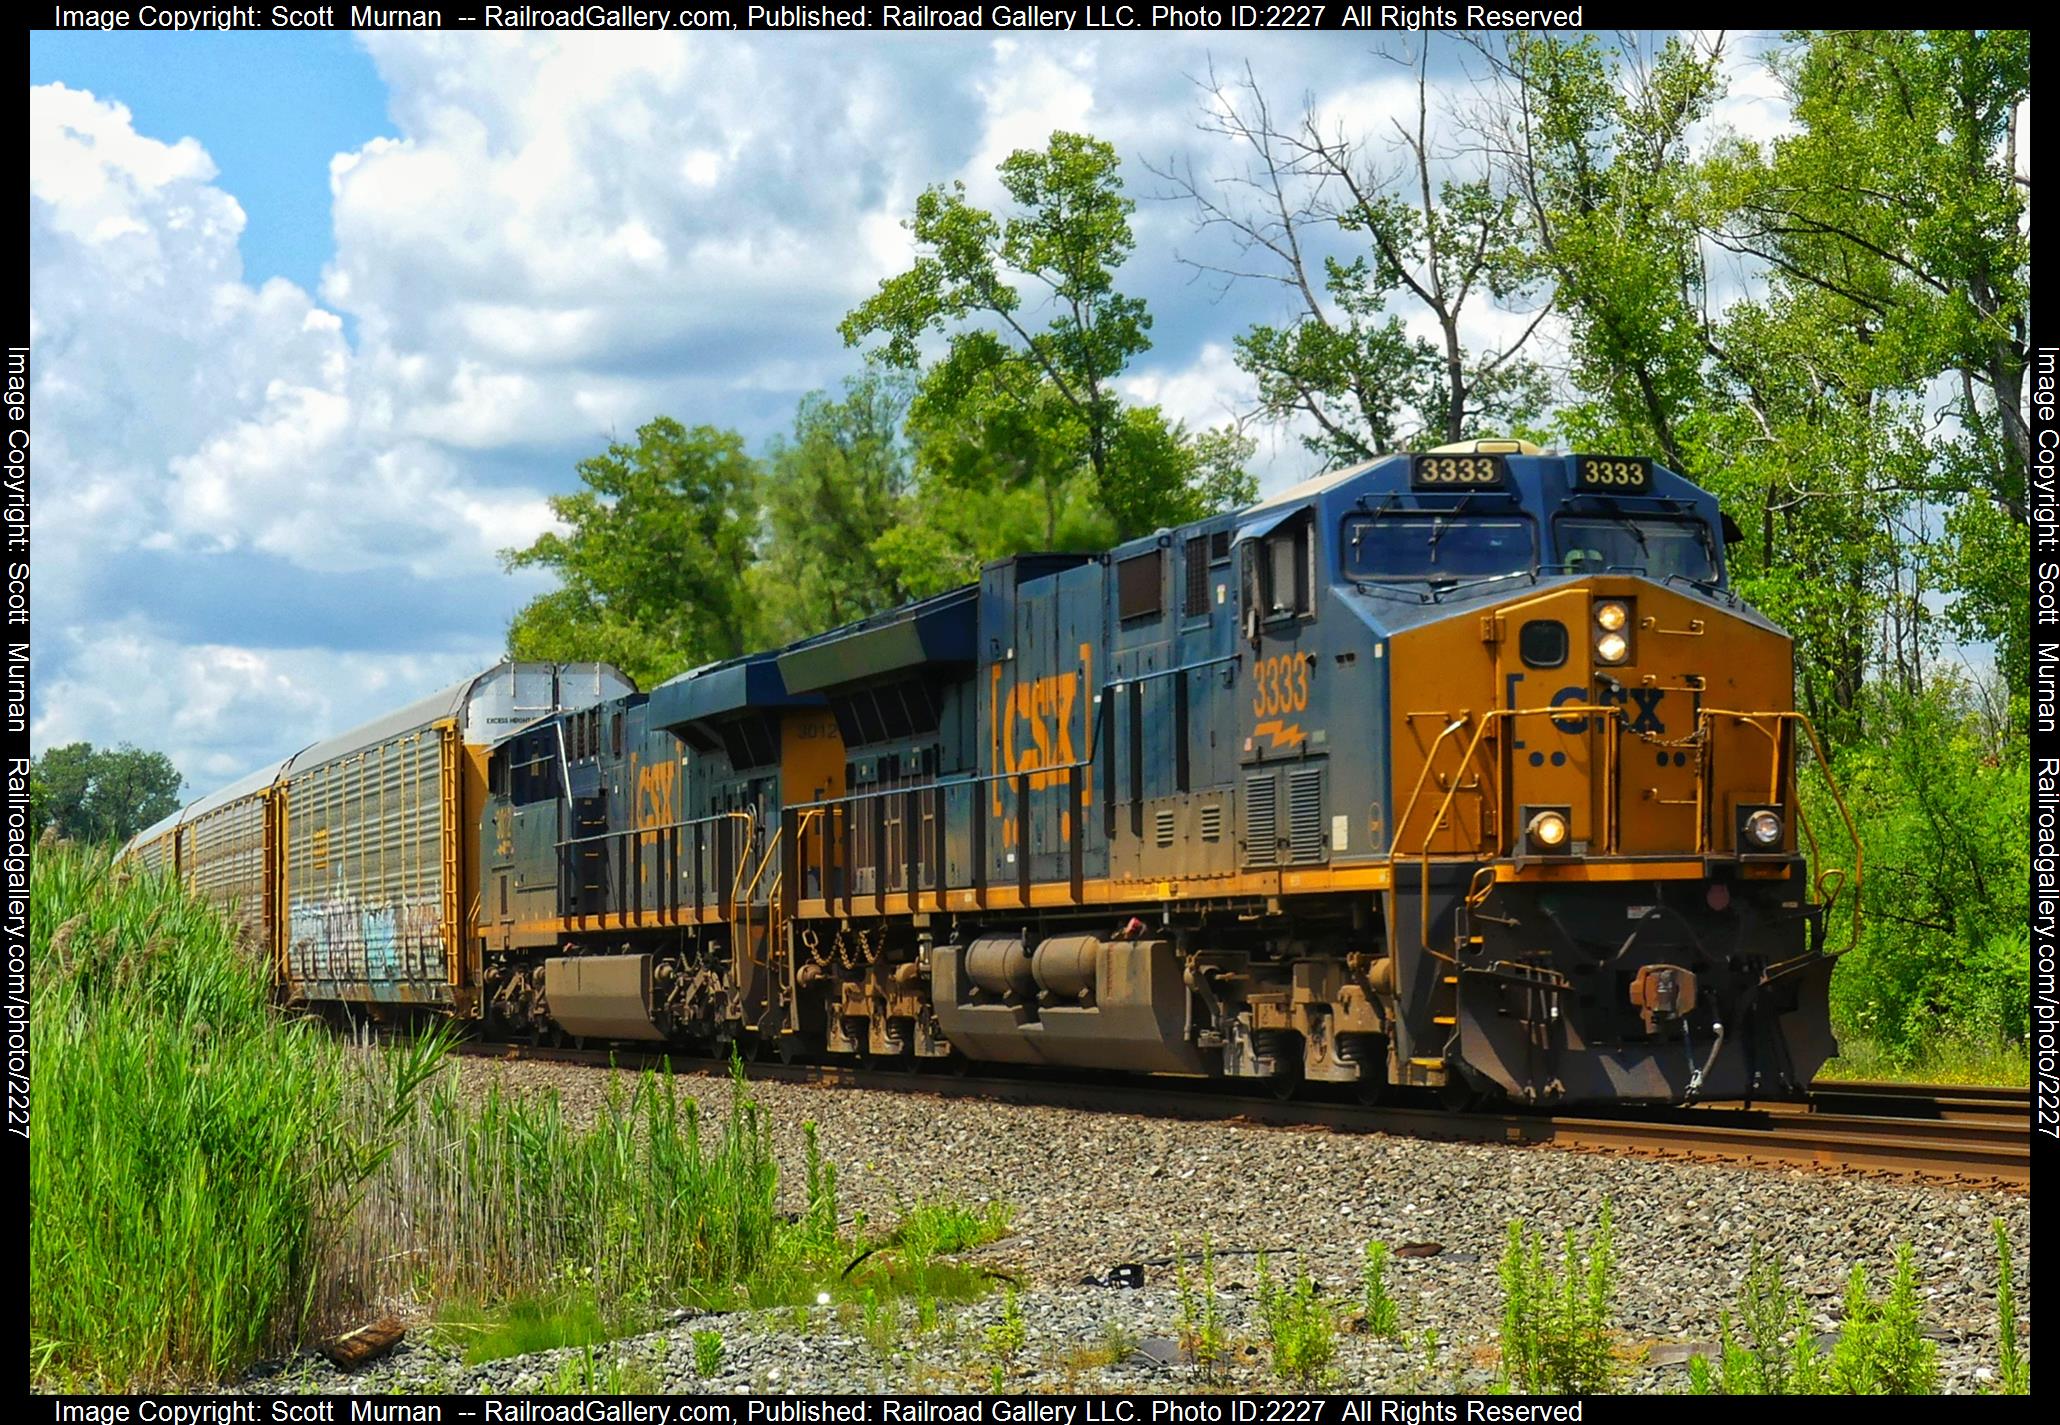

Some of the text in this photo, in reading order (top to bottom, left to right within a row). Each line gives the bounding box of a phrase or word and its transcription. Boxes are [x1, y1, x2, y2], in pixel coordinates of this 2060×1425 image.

[1421, 458, 1495, 483] 3333
[1585, 461, 1645, 485] 3333
[1253, 652, 1309, 718] 3333
